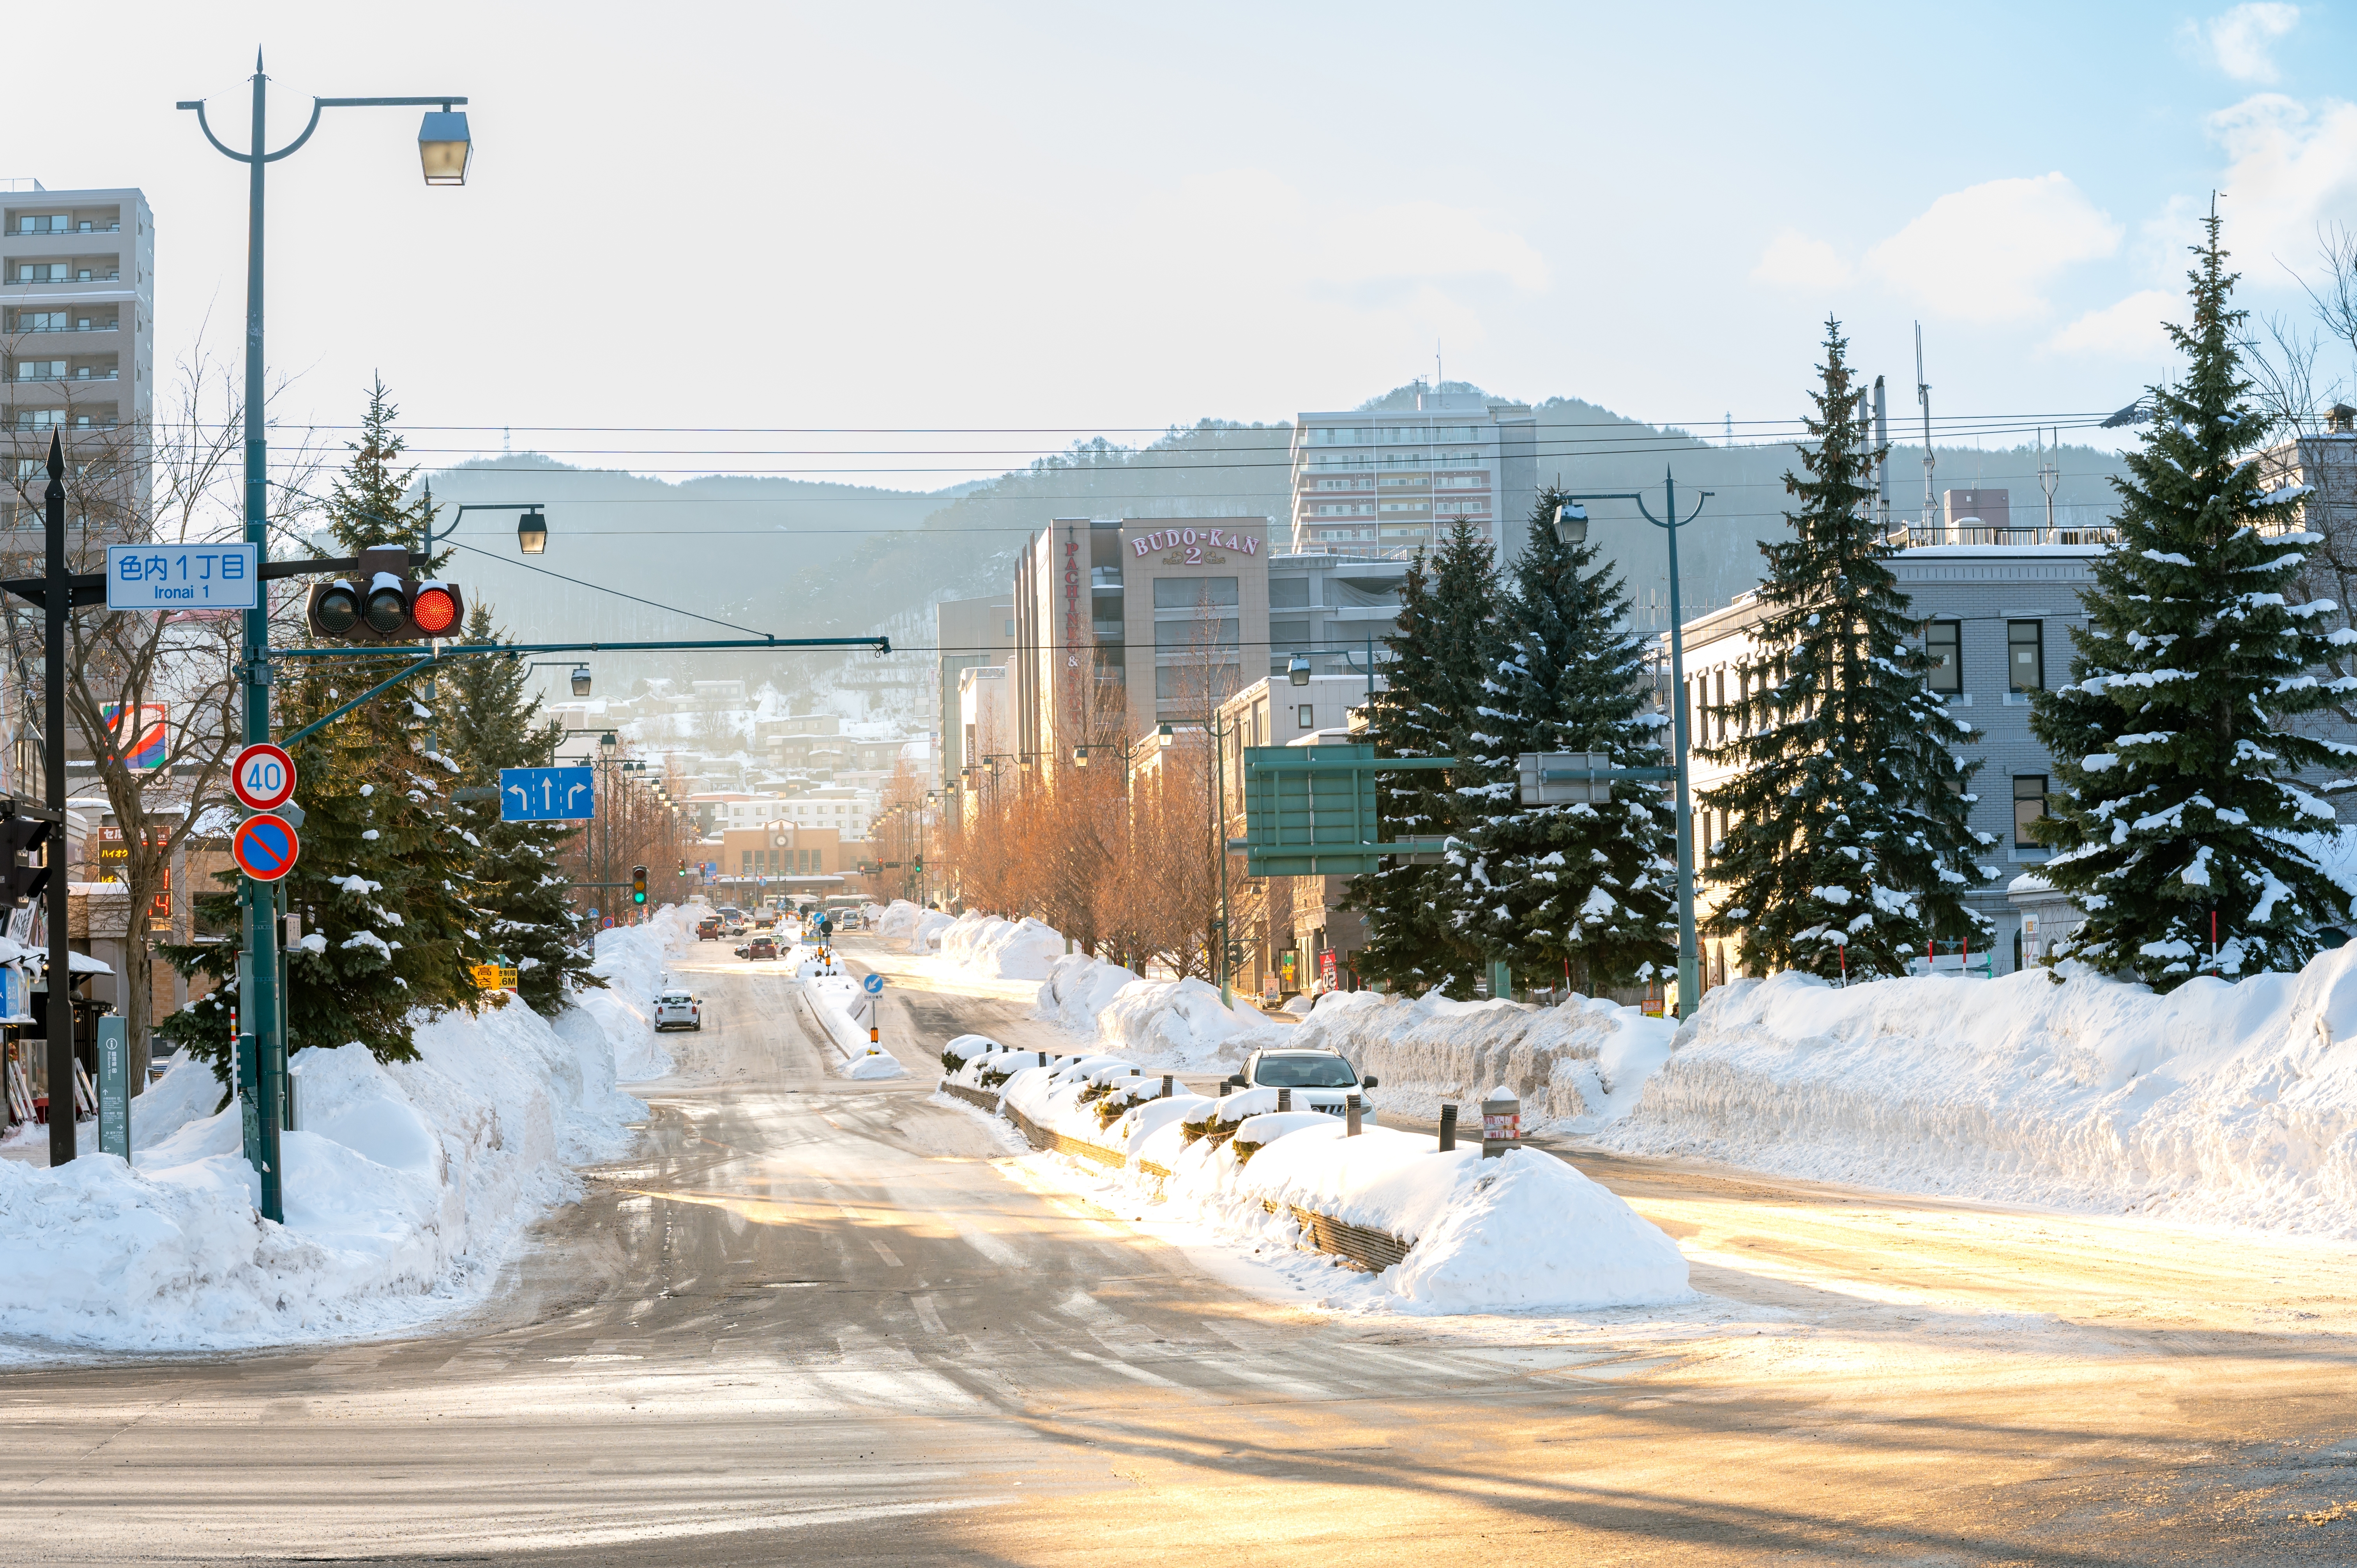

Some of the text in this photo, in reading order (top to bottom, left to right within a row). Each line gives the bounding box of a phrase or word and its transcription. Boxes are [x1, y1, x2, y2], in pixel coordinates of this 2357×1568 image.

[1131, 528, 1259, 557] BUDO-KAN
[119, 554, 244, 581] 色内1丁目
[1184, 547, 1202, 565] 2
[155, 585, 208, 599] Ironai 1
[1065, 542, 1079, 653] PACHINKO
[1068, 655, 1078, 667] &
[247, 763, 281, 791] 40
[102, 849, 128, 858] ハイオク
[477, 967, 492, 990] 高さ
